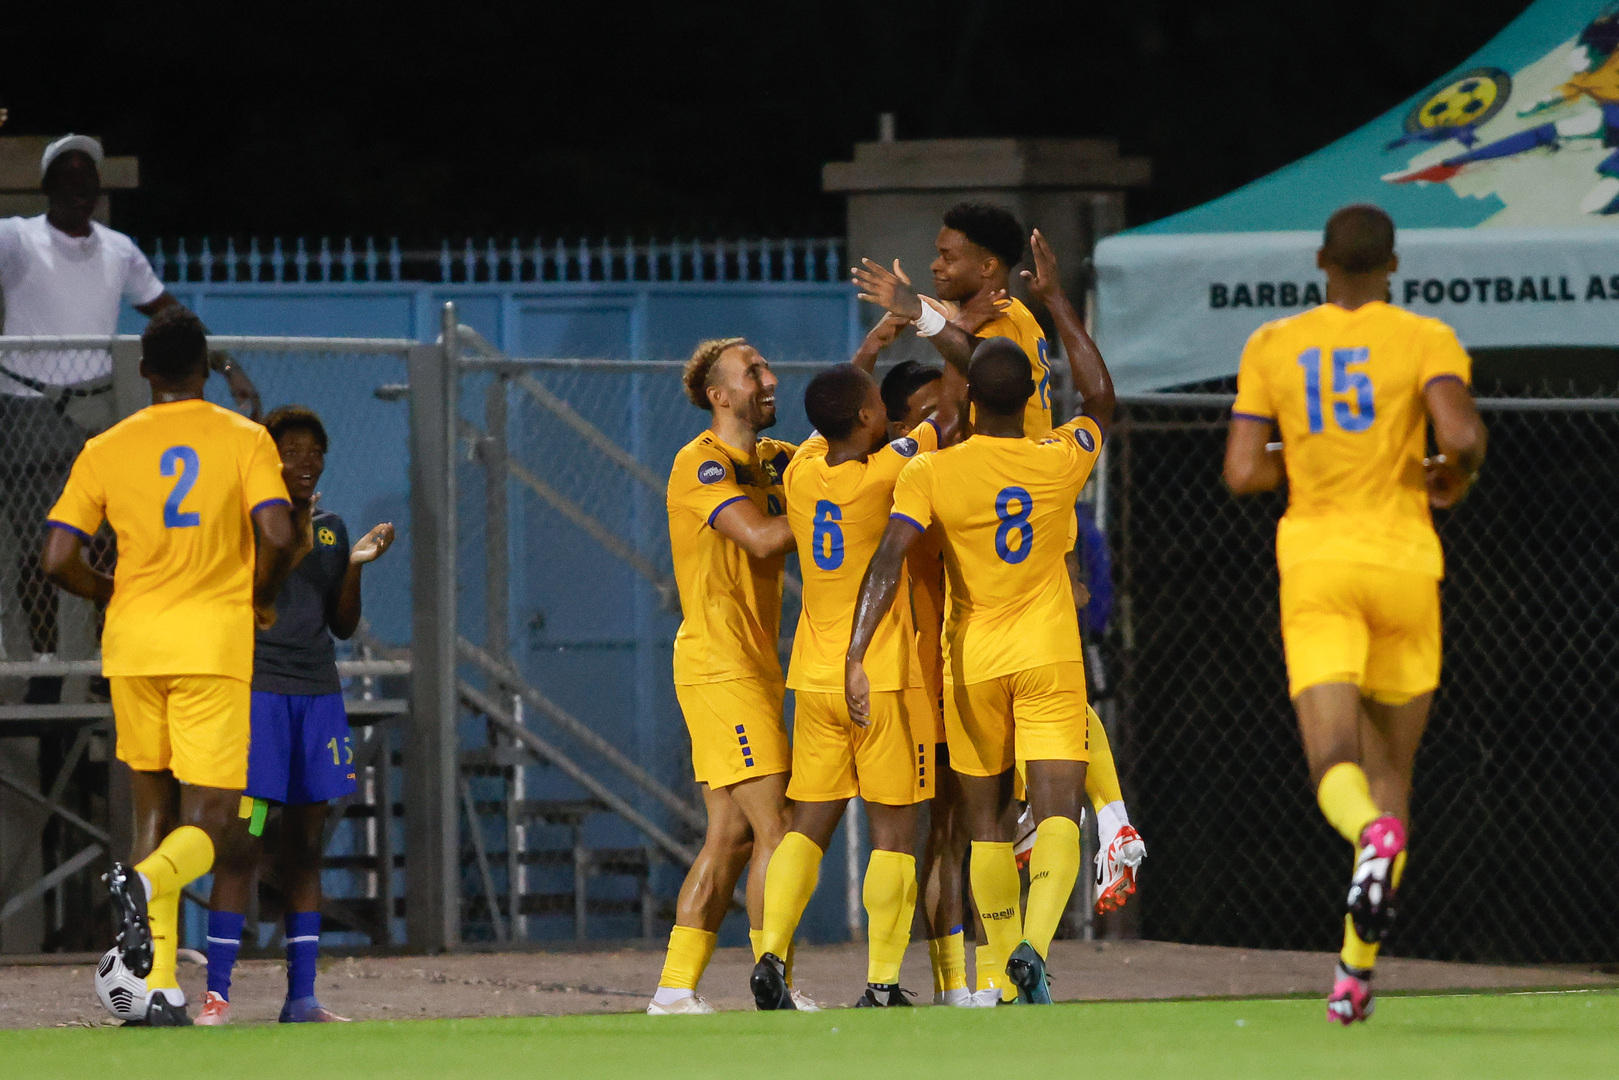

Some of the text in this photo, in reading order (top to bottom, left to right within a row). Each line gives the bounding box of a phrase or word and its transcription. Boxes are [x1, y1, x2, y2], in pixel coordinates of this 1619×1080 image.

[1403, 276, 1574, 303] FOOTBALL
[1298, 347, 1375, 432] 15
[160, 446, 200, 528] 2
[812, 499, 845, 571] 6
[995, 486, 1033, 564] 8
[981, 906, 1016, 920] capelli
